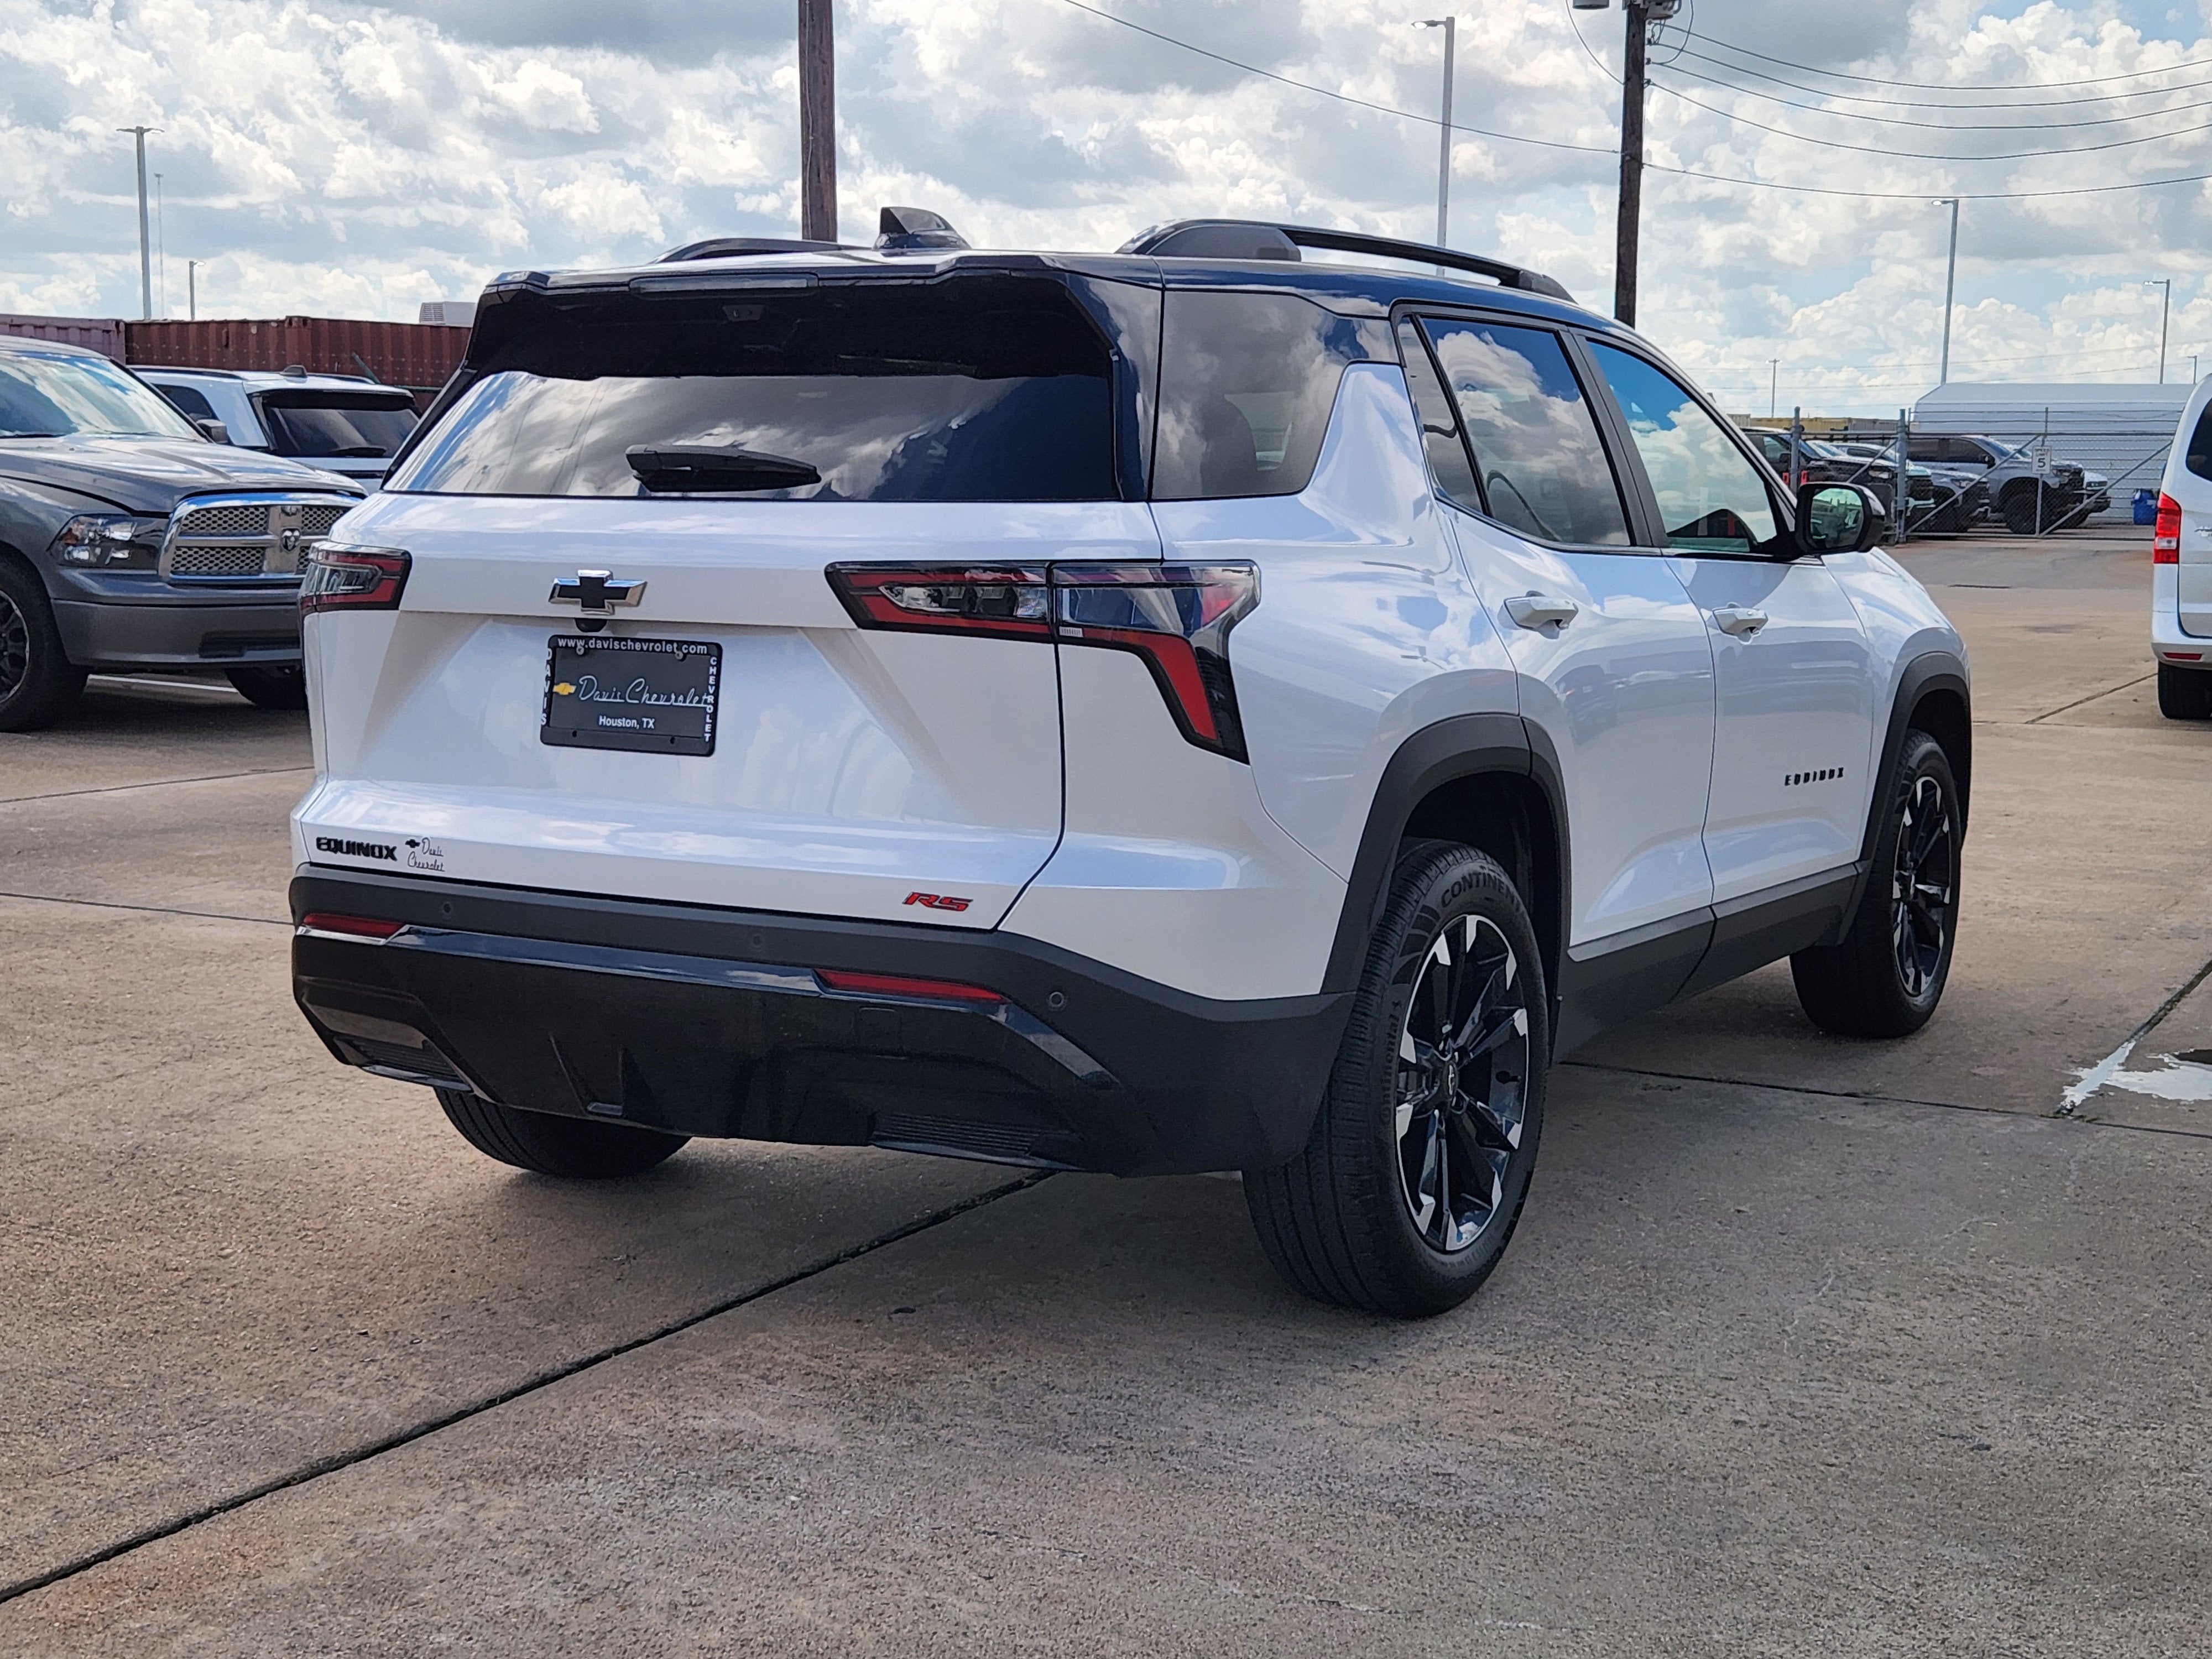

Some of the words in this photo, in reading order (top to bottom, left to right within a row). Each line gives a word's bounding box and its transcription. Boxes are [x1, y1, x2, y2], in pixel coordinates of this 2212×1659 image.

[2037, 458, 2046, 468] 5
[557, 638, 707, 655] www.davischevroletcom
[578, 675, 625, 702] Davis
[625, 678, 710, 707] Chevrolet
[704, 656, 718, 742] CHEVROLET
[599, 715, 640, 729] Houston,
[641, 717, 655, 729] TX
[316, 837, 398, 862] EQUINOX
[902, 891, 974, 912] RS
[1441, 872, 1520, 911] CONTINE
